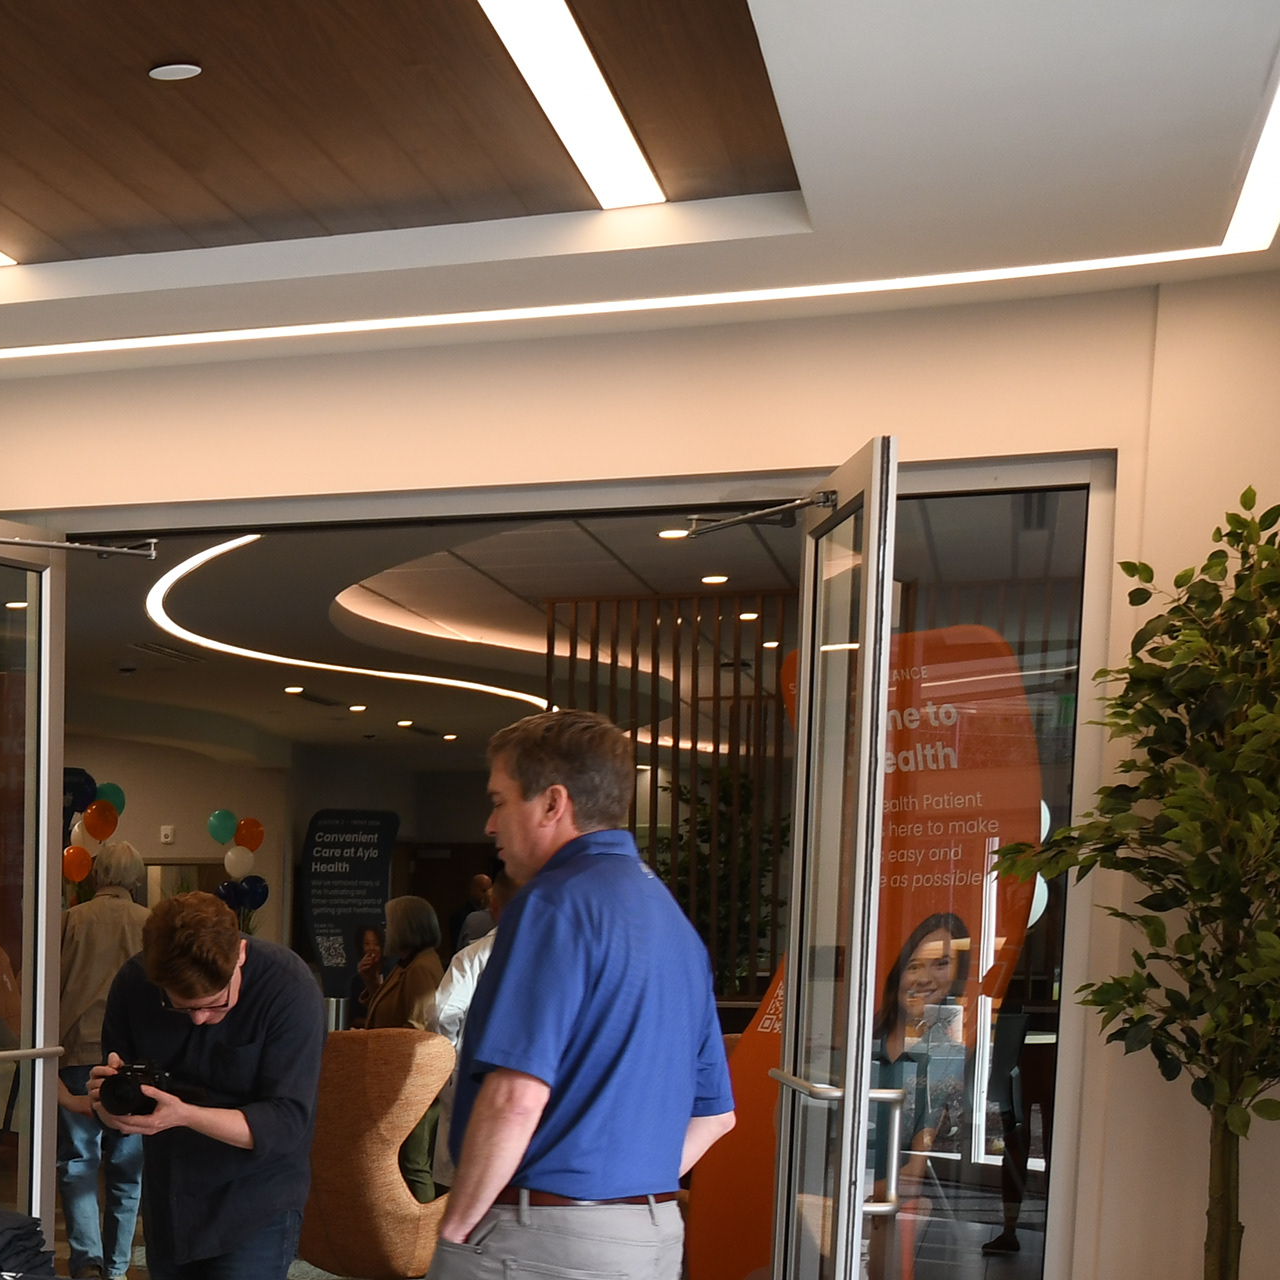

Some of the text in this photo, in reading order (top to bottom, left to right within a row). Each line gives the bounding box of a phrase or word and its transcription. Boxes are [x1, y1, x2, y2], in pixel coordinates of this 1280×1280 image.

[890, 666, 928, 682] ANCE
[925, 701, 958, 727] to
[884, 742, 958, 774] ealth
[883, 791, 983, 812] ealth Patient
[889, 820, 923, 837] here
[927, 821, 944, 835] to
[948, 817, 999, 834] make
[315, 831, 379, 843] Convenient
[312, 847, 379, 861] Care at Aylo
[888, 848, 925, 867] easy
[928, 844, 962, 861] and
[311, 861, 350, 873] Health
[890, 873, 908, 887] as
